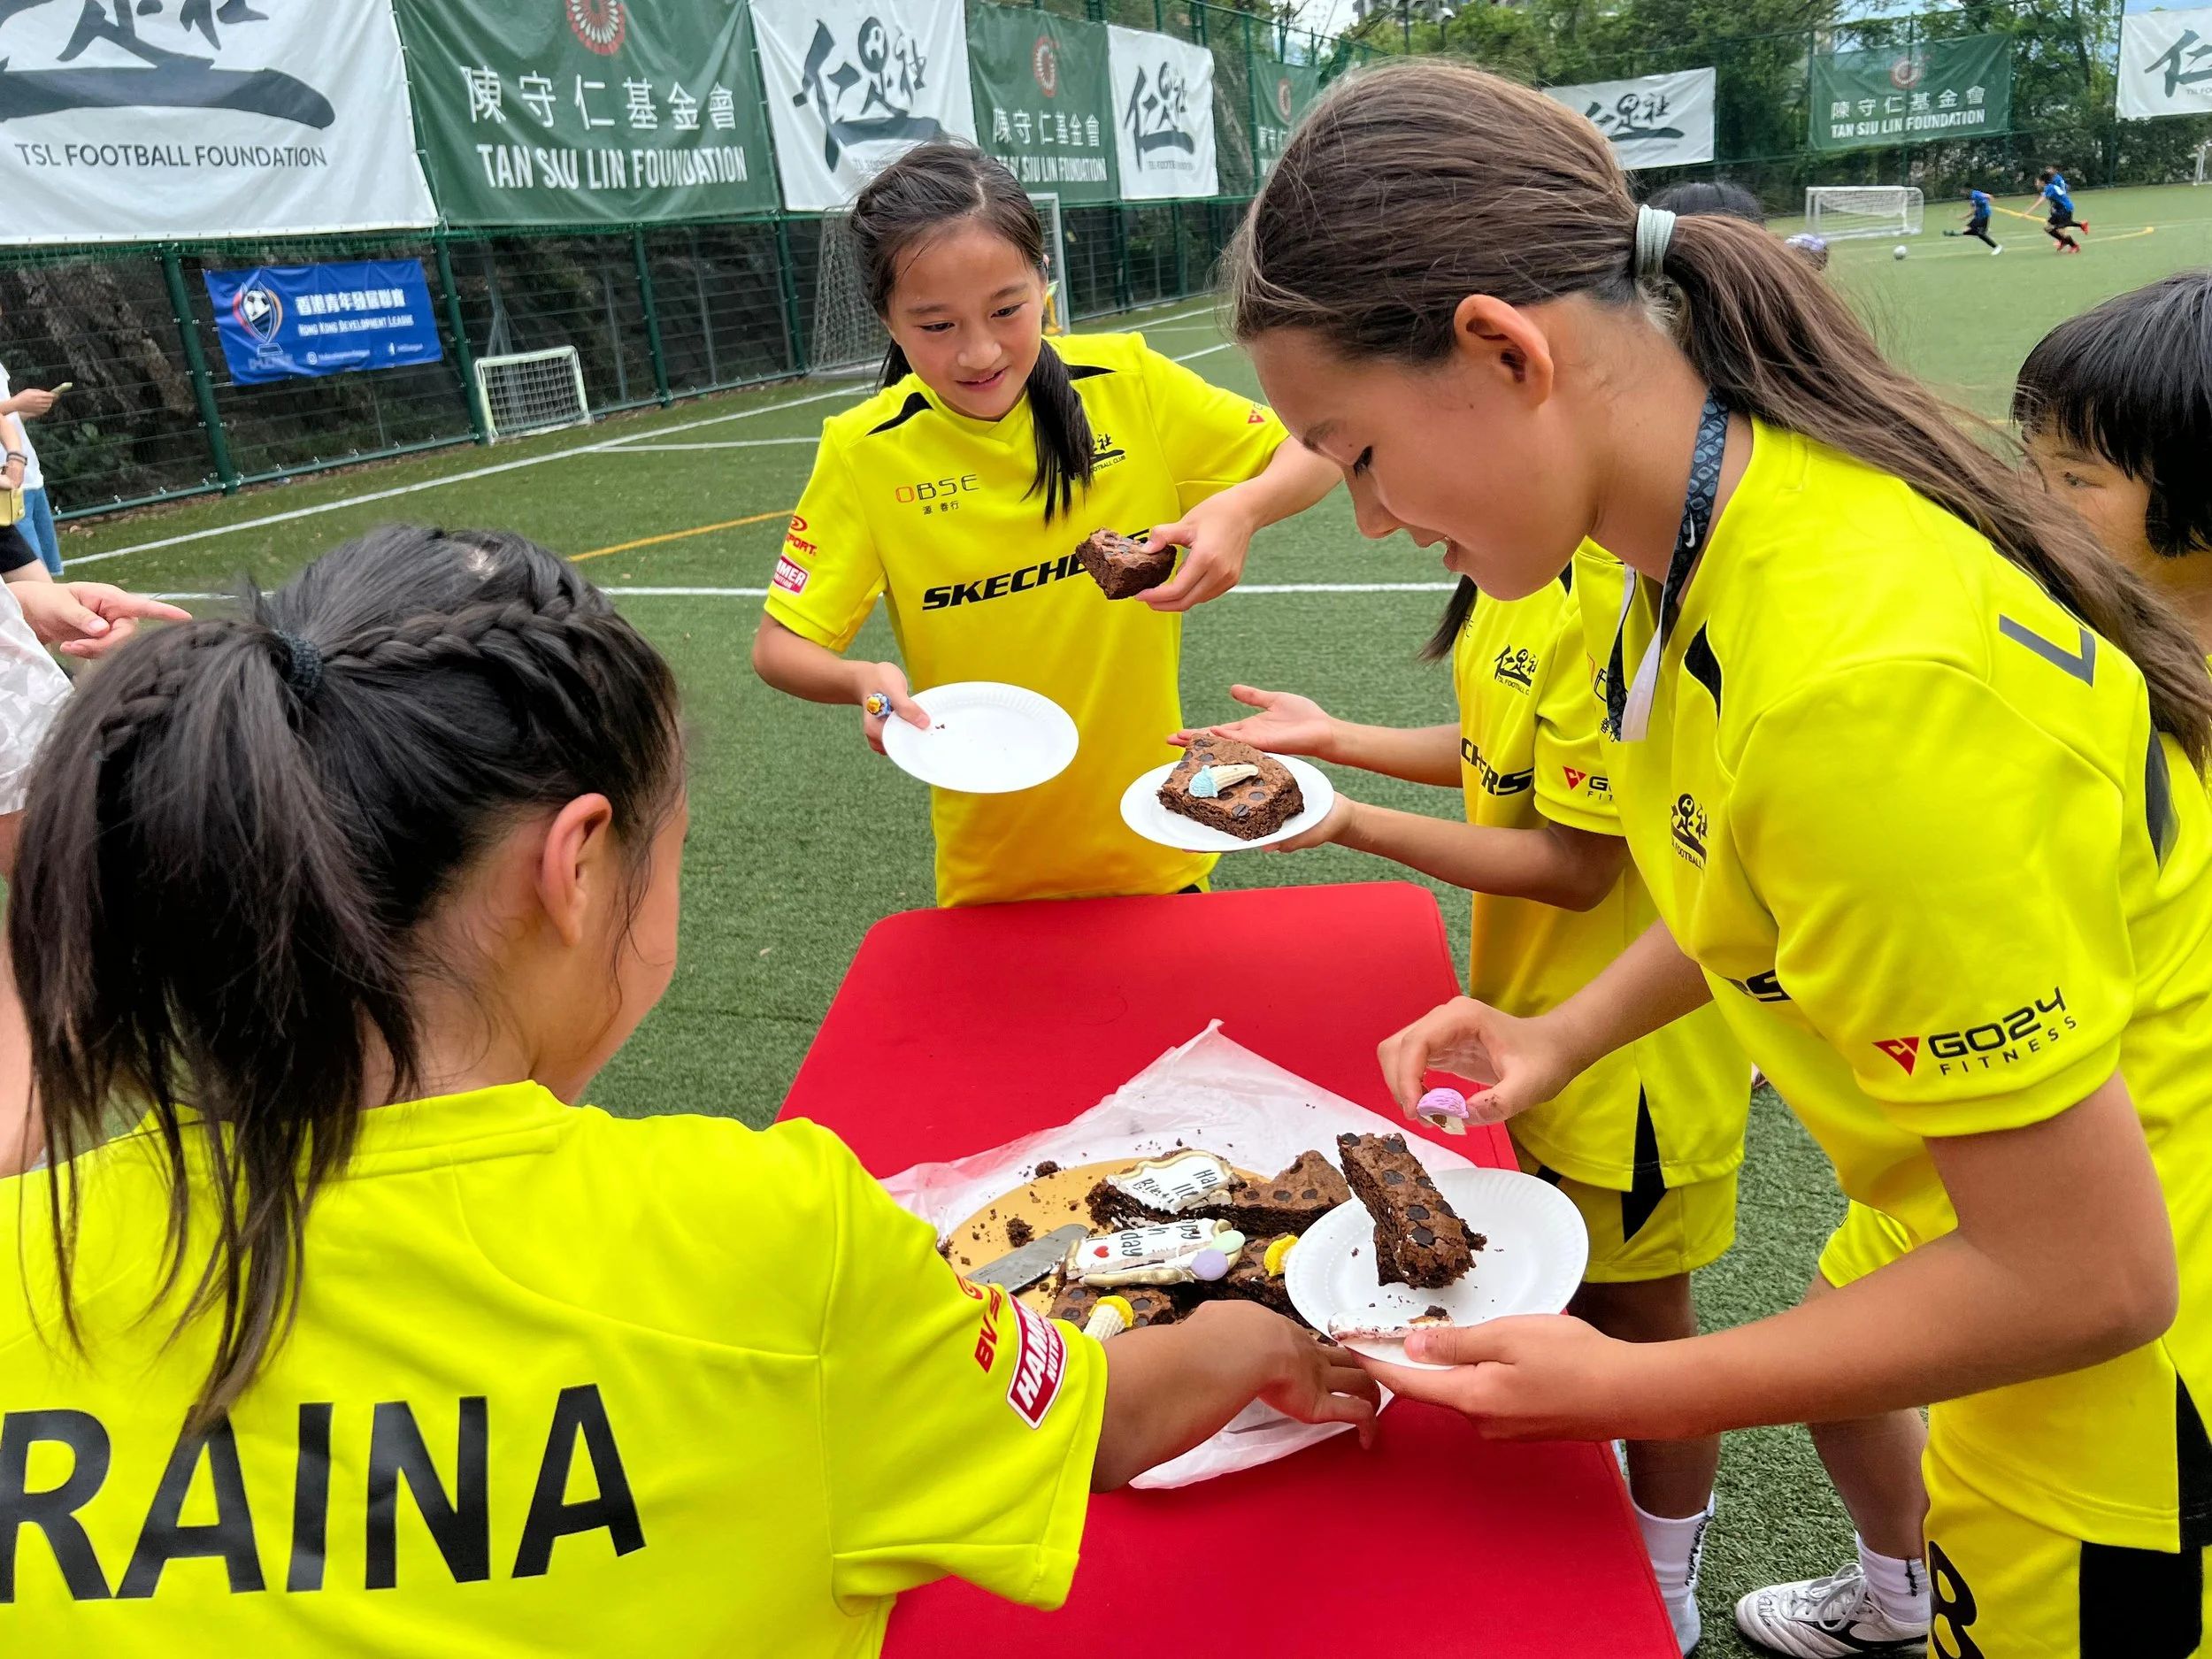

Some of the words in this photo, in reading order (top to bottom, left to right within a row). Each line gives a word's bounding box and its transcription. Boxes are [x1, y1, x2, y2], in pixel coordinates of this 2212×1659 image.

[460, 65, 736, 130] 陳守仁基金會
[1832, 86, 1985, 120] 陳守仁基金會
[993, 107, 1100, 147] 陳守仁基金會
[1831, 123, 1855, 138] TAN
[1857, 120, 1878, 135] SIU
[1881, 118, 1902, 134] LIN
[1906, 109, 1985, 131] FOUNDATION
[15, 143, 61, 166] TSL
[65, 144, 191, 166] FOOTBALL
[195, 145, 328, 166] FOUNDATION
[477, 143, 534, 188] TAN
[535, 148, 580, 188] SIU
[588, 149, 627, 188] LIN
[631, 146, 749, 188] FOUNDATION
[895, 473, 979, 503] OBSE
[1927, 986, 2066, 1059] GO24
[1939, 1016, 2077, 1076] FITNESS
[0, 1383, 647, 1603] RAINA
